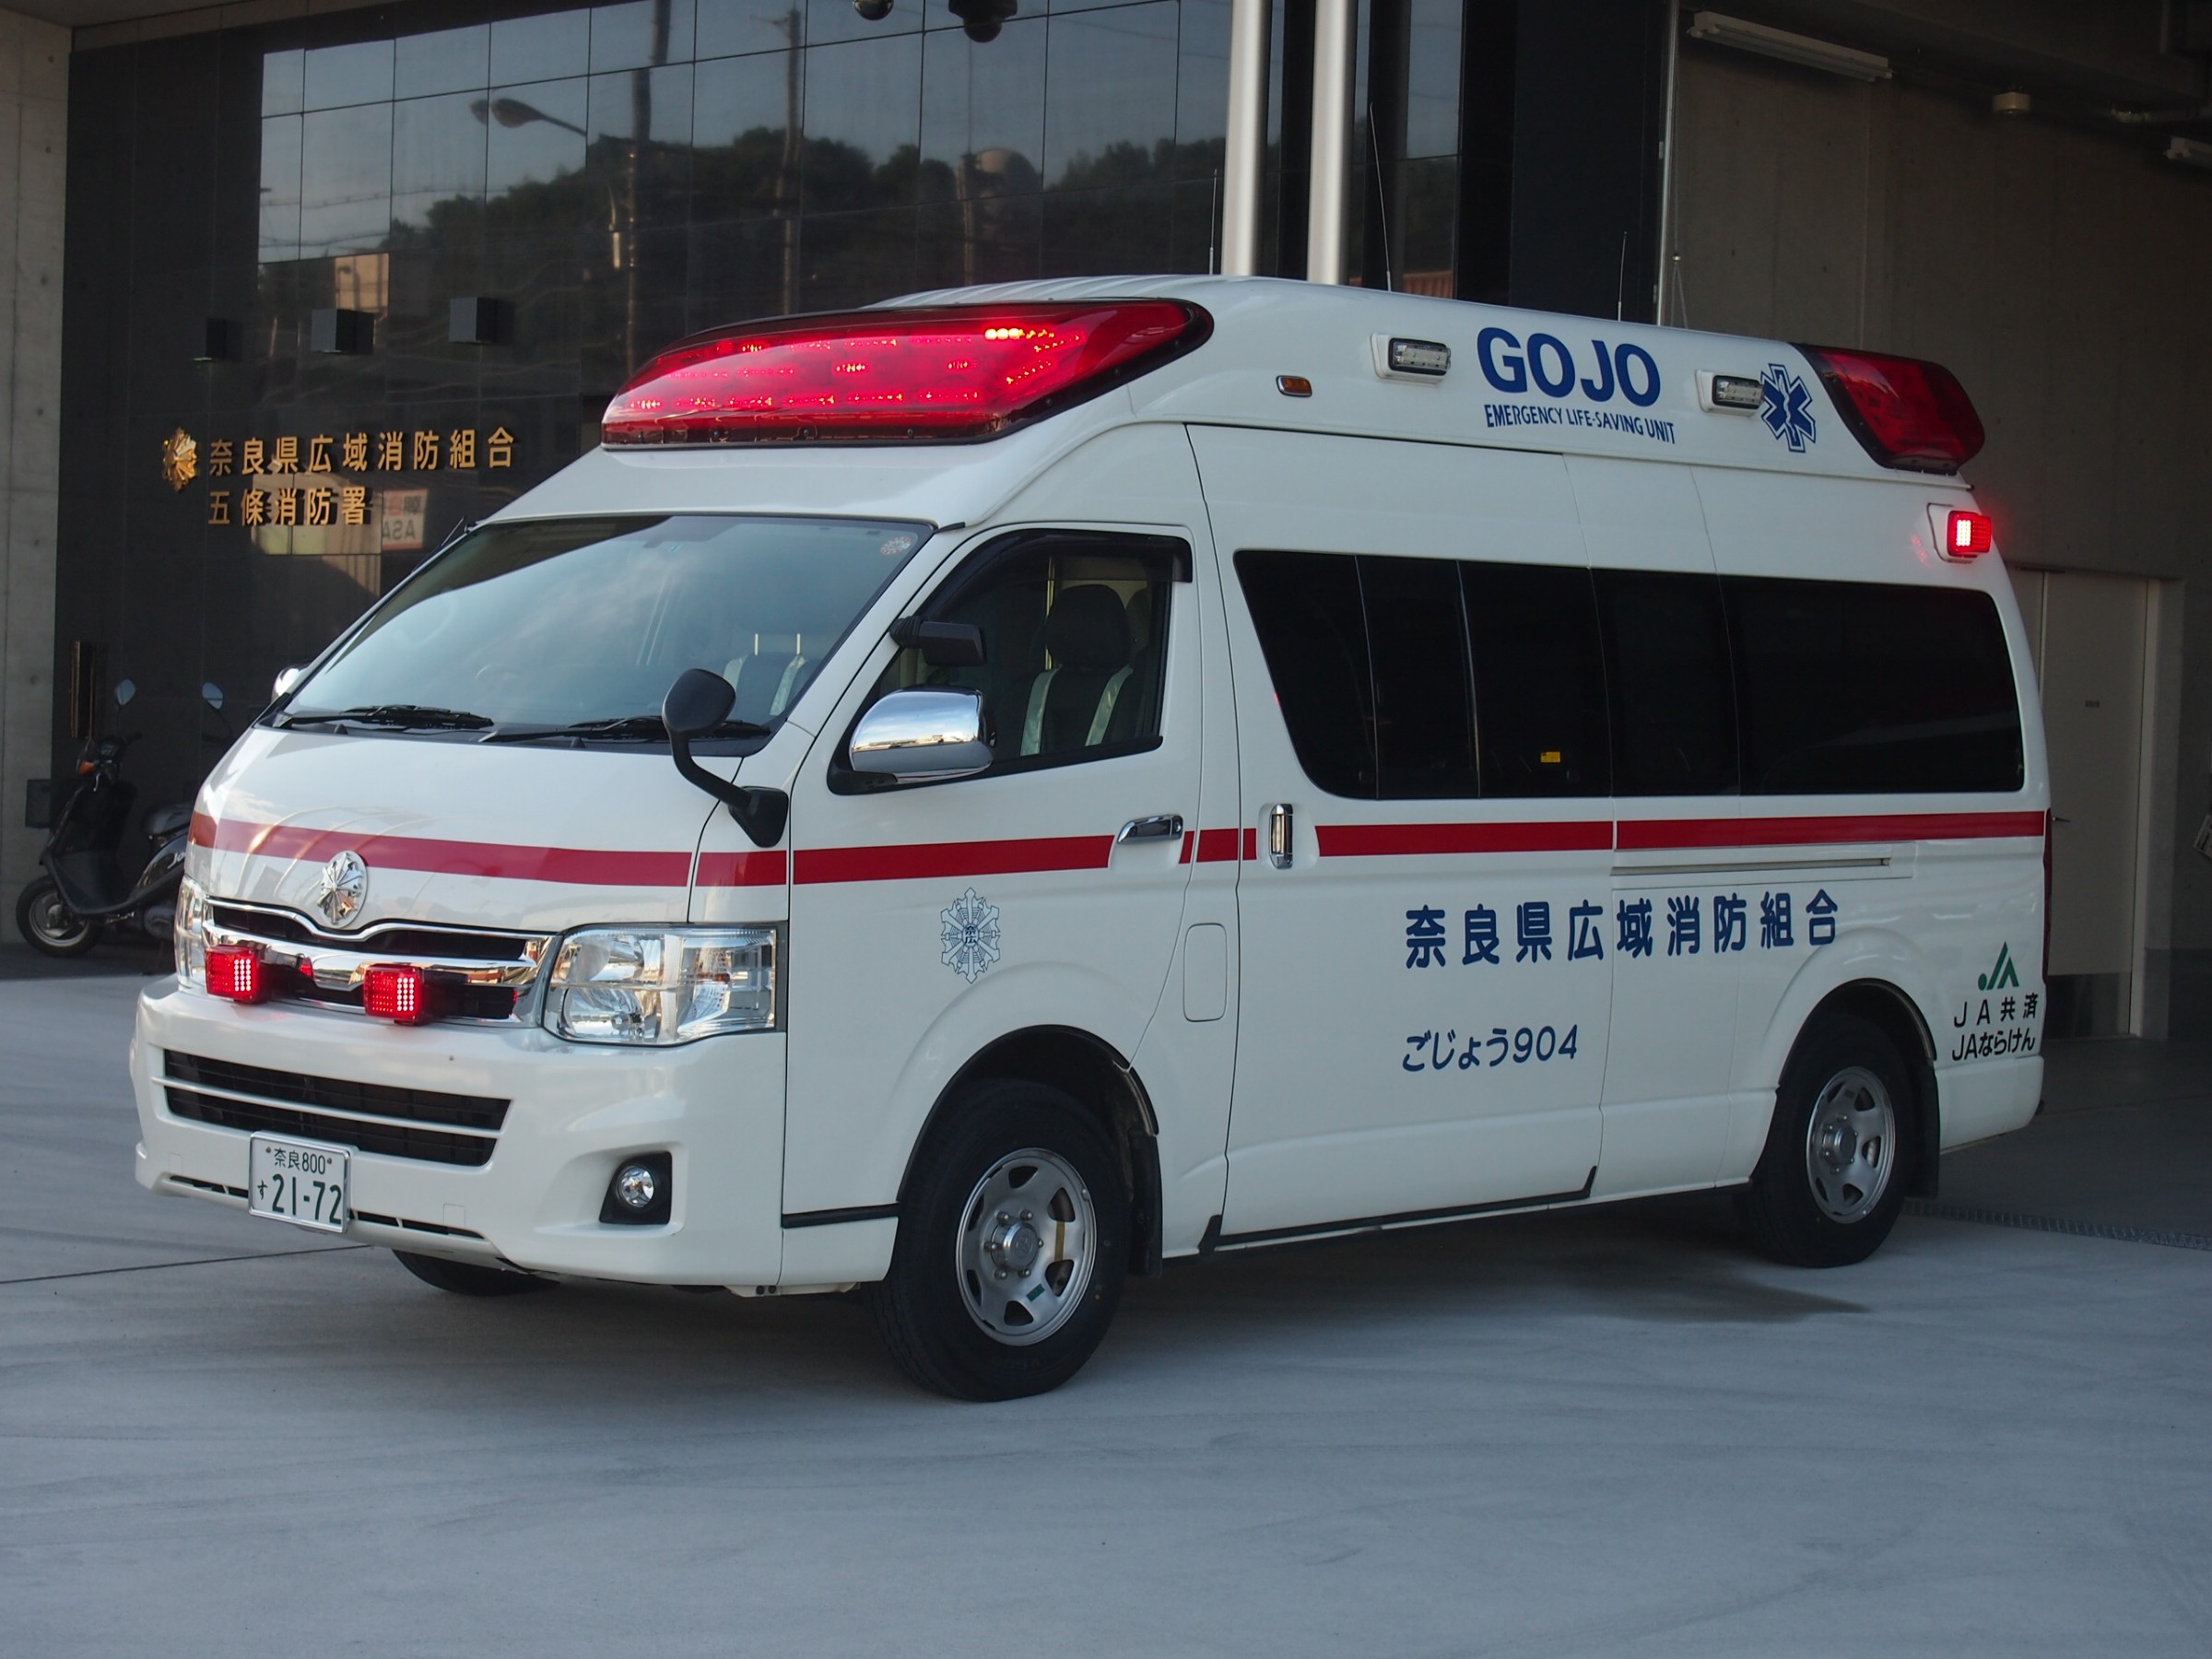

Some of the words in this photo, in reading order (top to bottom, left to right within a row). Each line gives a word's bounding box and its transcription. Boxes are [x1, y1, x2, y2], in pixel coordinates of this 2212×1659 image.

[1477, 327, 1661, 406] GOJO
[1484, 404, 1563, 428] EMERGENCY
[1566, 408, 1644, 436] LIFE-SAVING
[1645, 418, 1676, 444] UNIT
[208, 427, 514, 477] 奈良県広域消防組合
[207, 486, 366, 526] 五條消防署
[1406, 889, 1838, 969] 奈良県広域消防組合
[1402, 1024, 1578, 1072] ごじょう904
[1952, 1028, 2036, 1061] JAならけん
